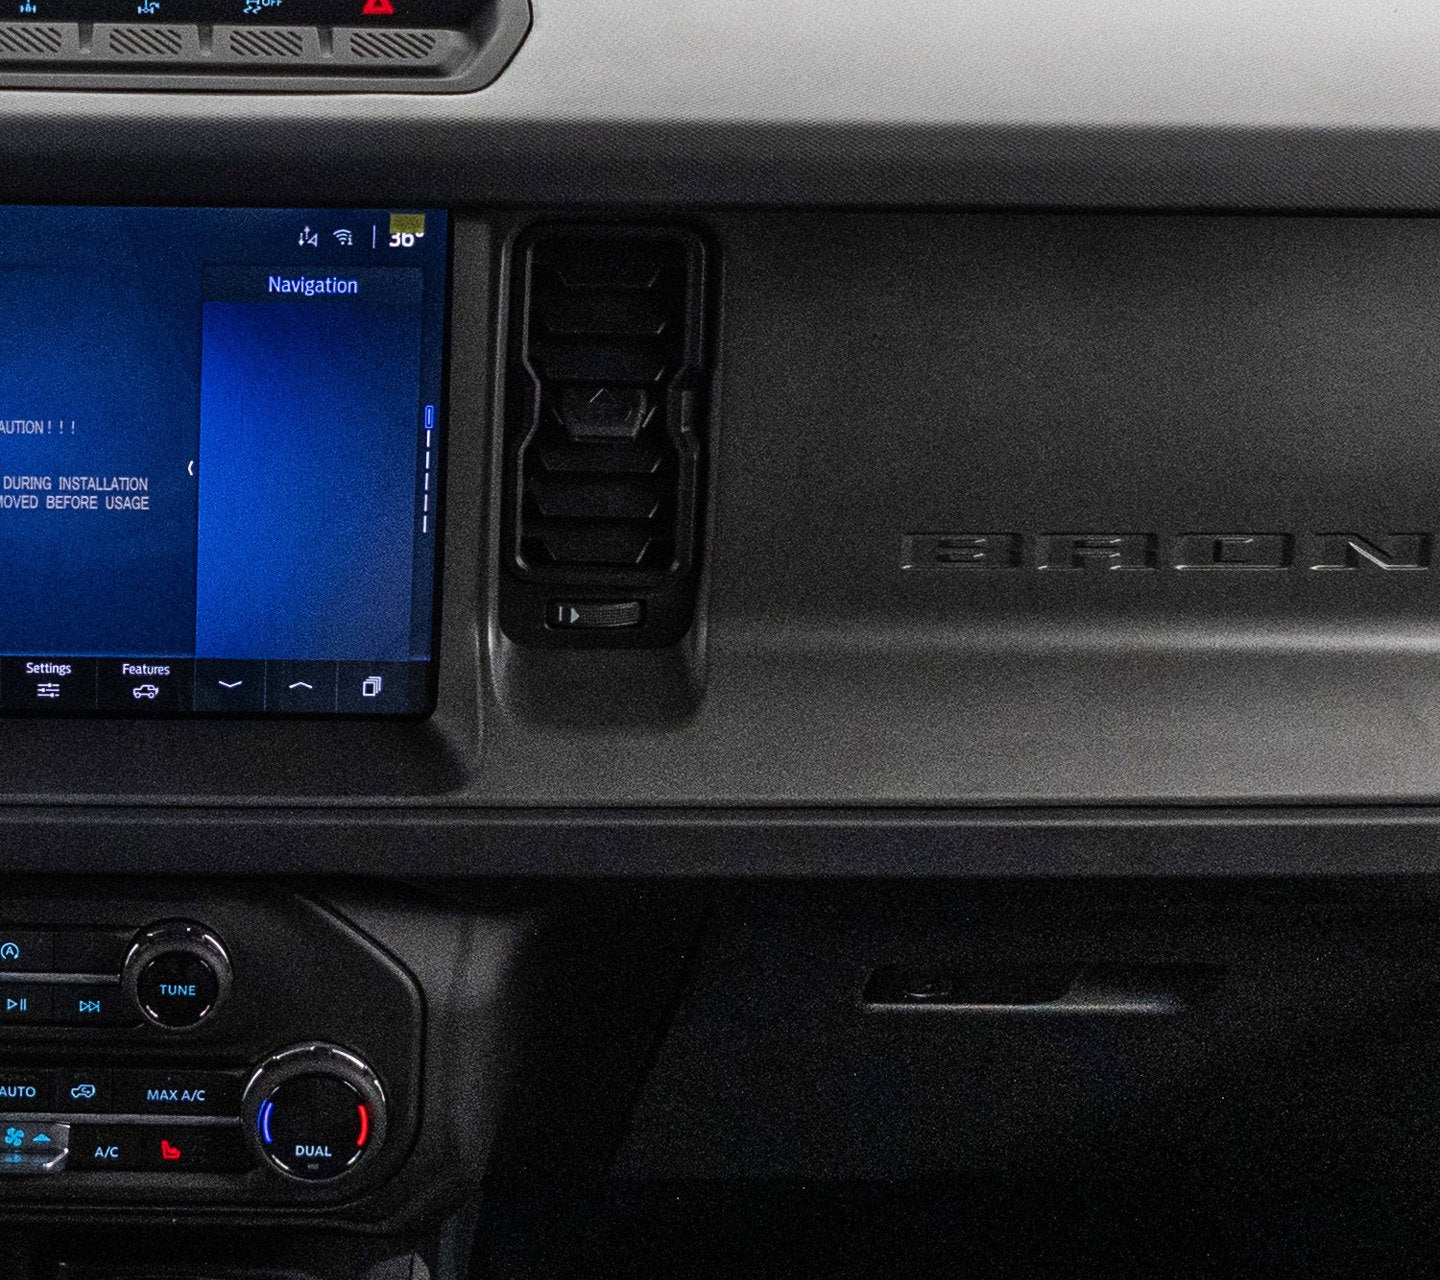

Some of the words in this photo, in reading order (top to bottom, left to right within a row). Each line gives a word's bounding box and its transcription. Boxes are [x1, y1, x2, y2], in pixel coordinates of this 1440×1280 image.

[267, 275, 358, 297] Navigation
[3, 477, 52, 490] DURING
[59, 477, 148, 491] INSTALLATION
[46, 496, 98, 510] BEFORE
[105, 496, 150, 510] USAGE
[25, 662, 72, 677] Settings
[122, 664, 170, 676] Features
[158, 983, 196, 997] TUNE
[147, 1088, 179, 1101] MAX
[181, 1088, 206, 1102] A/C
[94, 1145, 119, 1159] A/C
[296, 1146, 332, 1156] DUAL
